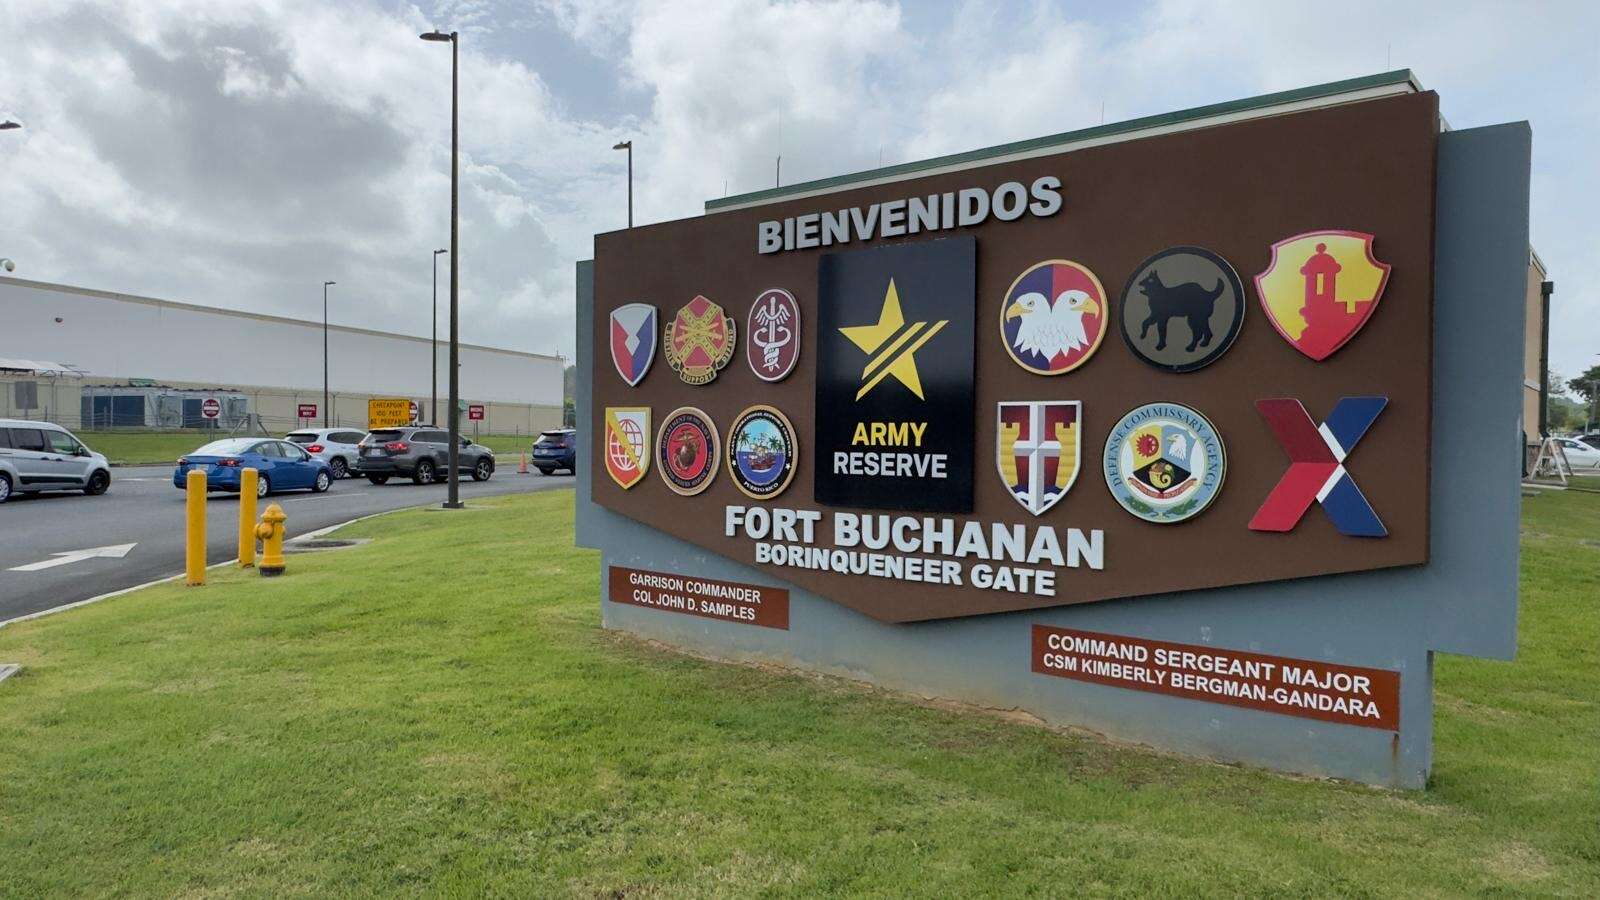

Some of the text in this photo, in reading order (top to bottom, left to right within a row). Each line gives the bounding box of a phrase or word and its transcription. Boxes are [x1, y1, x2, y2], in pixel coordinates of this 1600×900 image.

[758, 176, 1063, 254] BIENVENIDOS
[851, 422, 928, 446] ARMY
[1108, 407, 1220, 490] DEFENSE COMMISSARY AGENCY
[744, 481, 779, 492] PUERTO RICO
[833, 452, 947, 478] RESERVE
[725, 505, 1104, 570] FORT BUCHANAN
[629, 572, 762, 603] GARRISON COMMANDER
[755, 542, 1056, 596] BORINQUENEER GATE
[633, 589, 756, 620] COL JOHN D. SAMPLES
[1043, 652, 1381, 719] CSM KIMBERLY BERGMAN-GANDARA
[1047, 633, 1372, 695] COMMAND SERGEANT MAJOR
